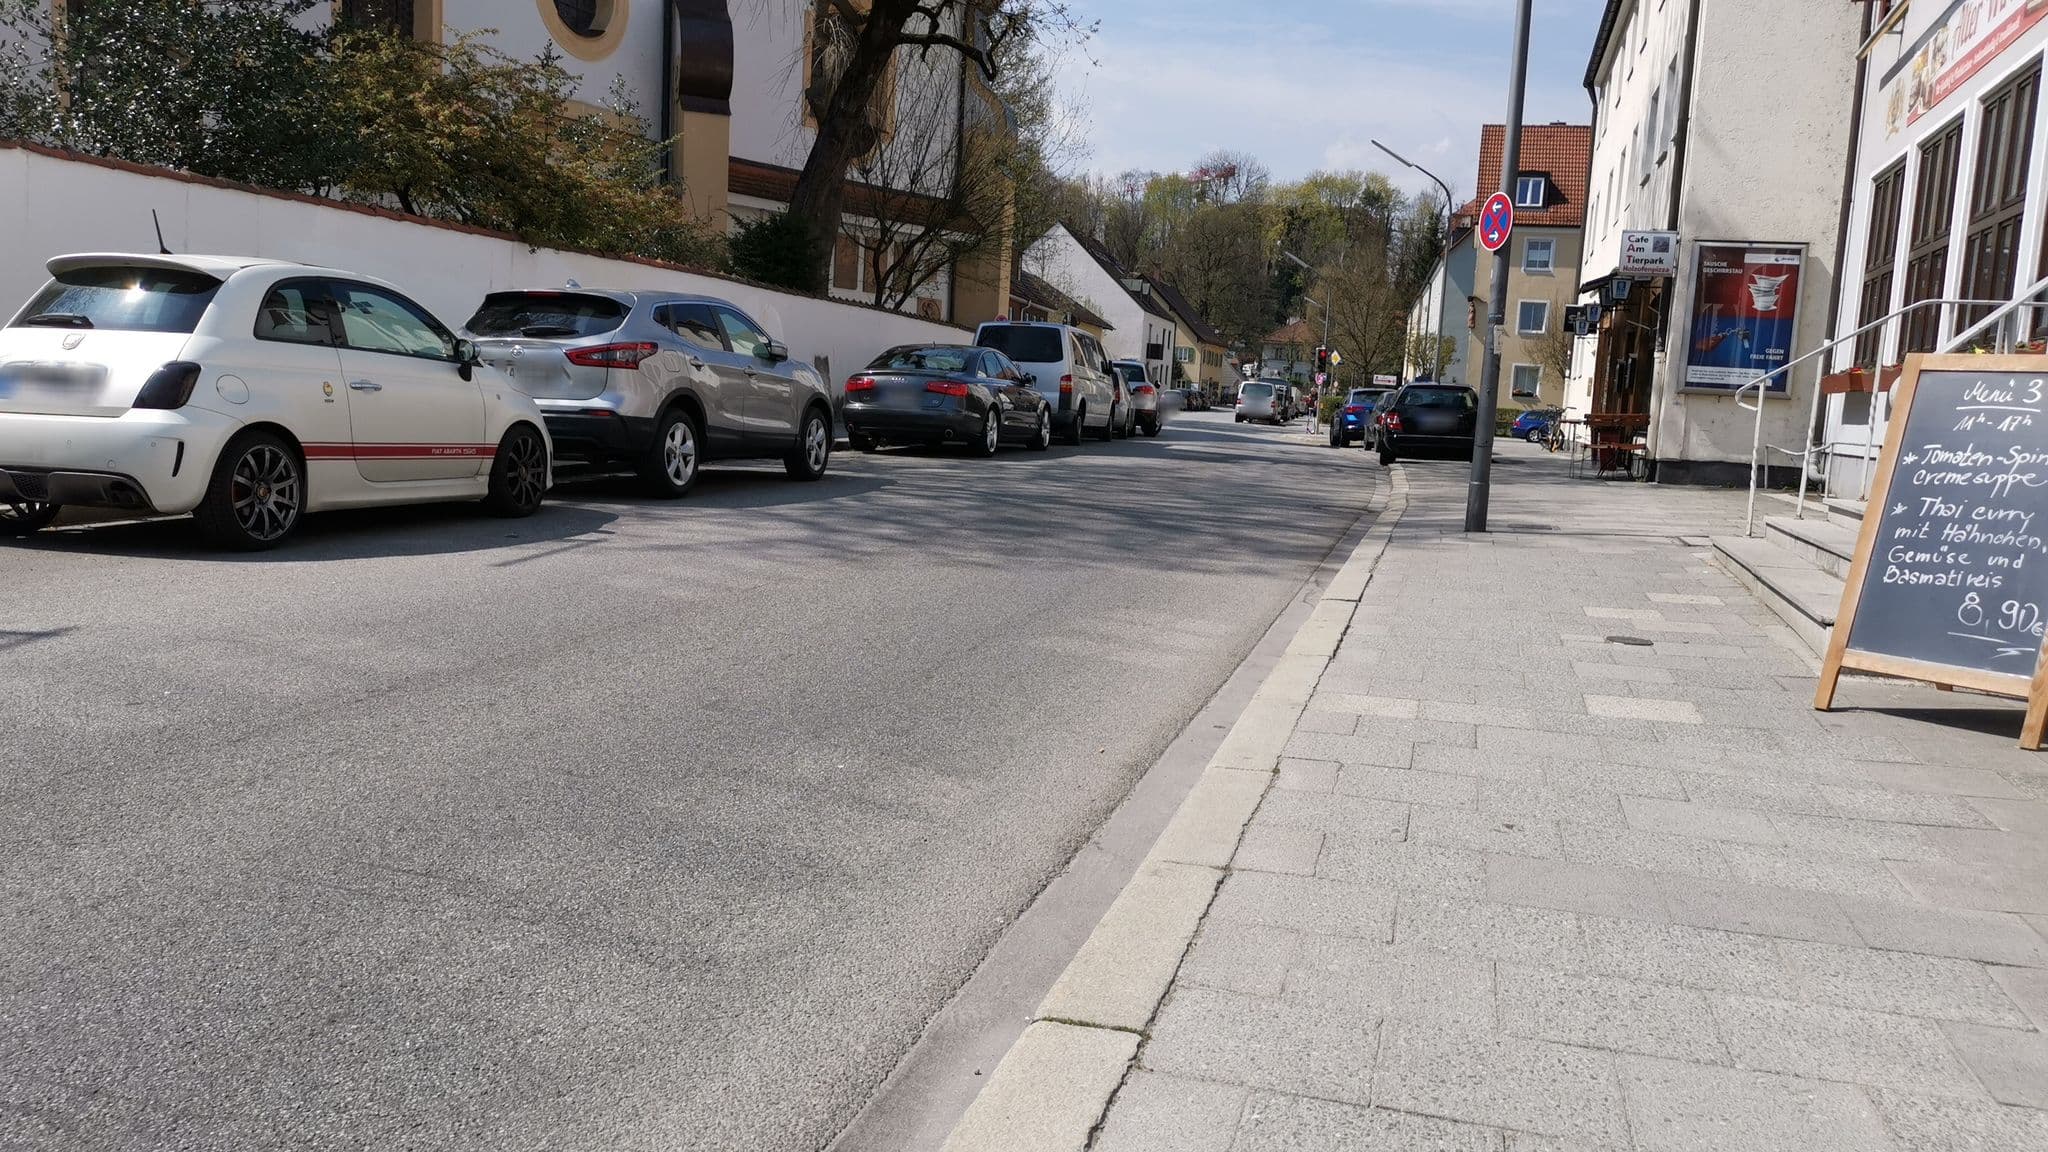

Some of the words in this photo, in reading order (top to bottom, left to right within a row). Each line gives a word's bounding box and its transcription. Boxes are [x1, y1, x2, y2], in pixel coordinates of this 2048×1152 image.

[1628, 234, 1649, 243] Cafe
[1626, 243, 1645, 253] Am
[1626, 255, 1665, 265] Tierpark
[1963, 379, 2015, 403] Menü
[2022, 378, 2044, 404] 3
[1919, 497, 1968, 518] Thai
[1894, 521, 1930, 539] mit
[1887, 545, 1972, 565] Gemüse
[1987, 553, 2025, 569] und
